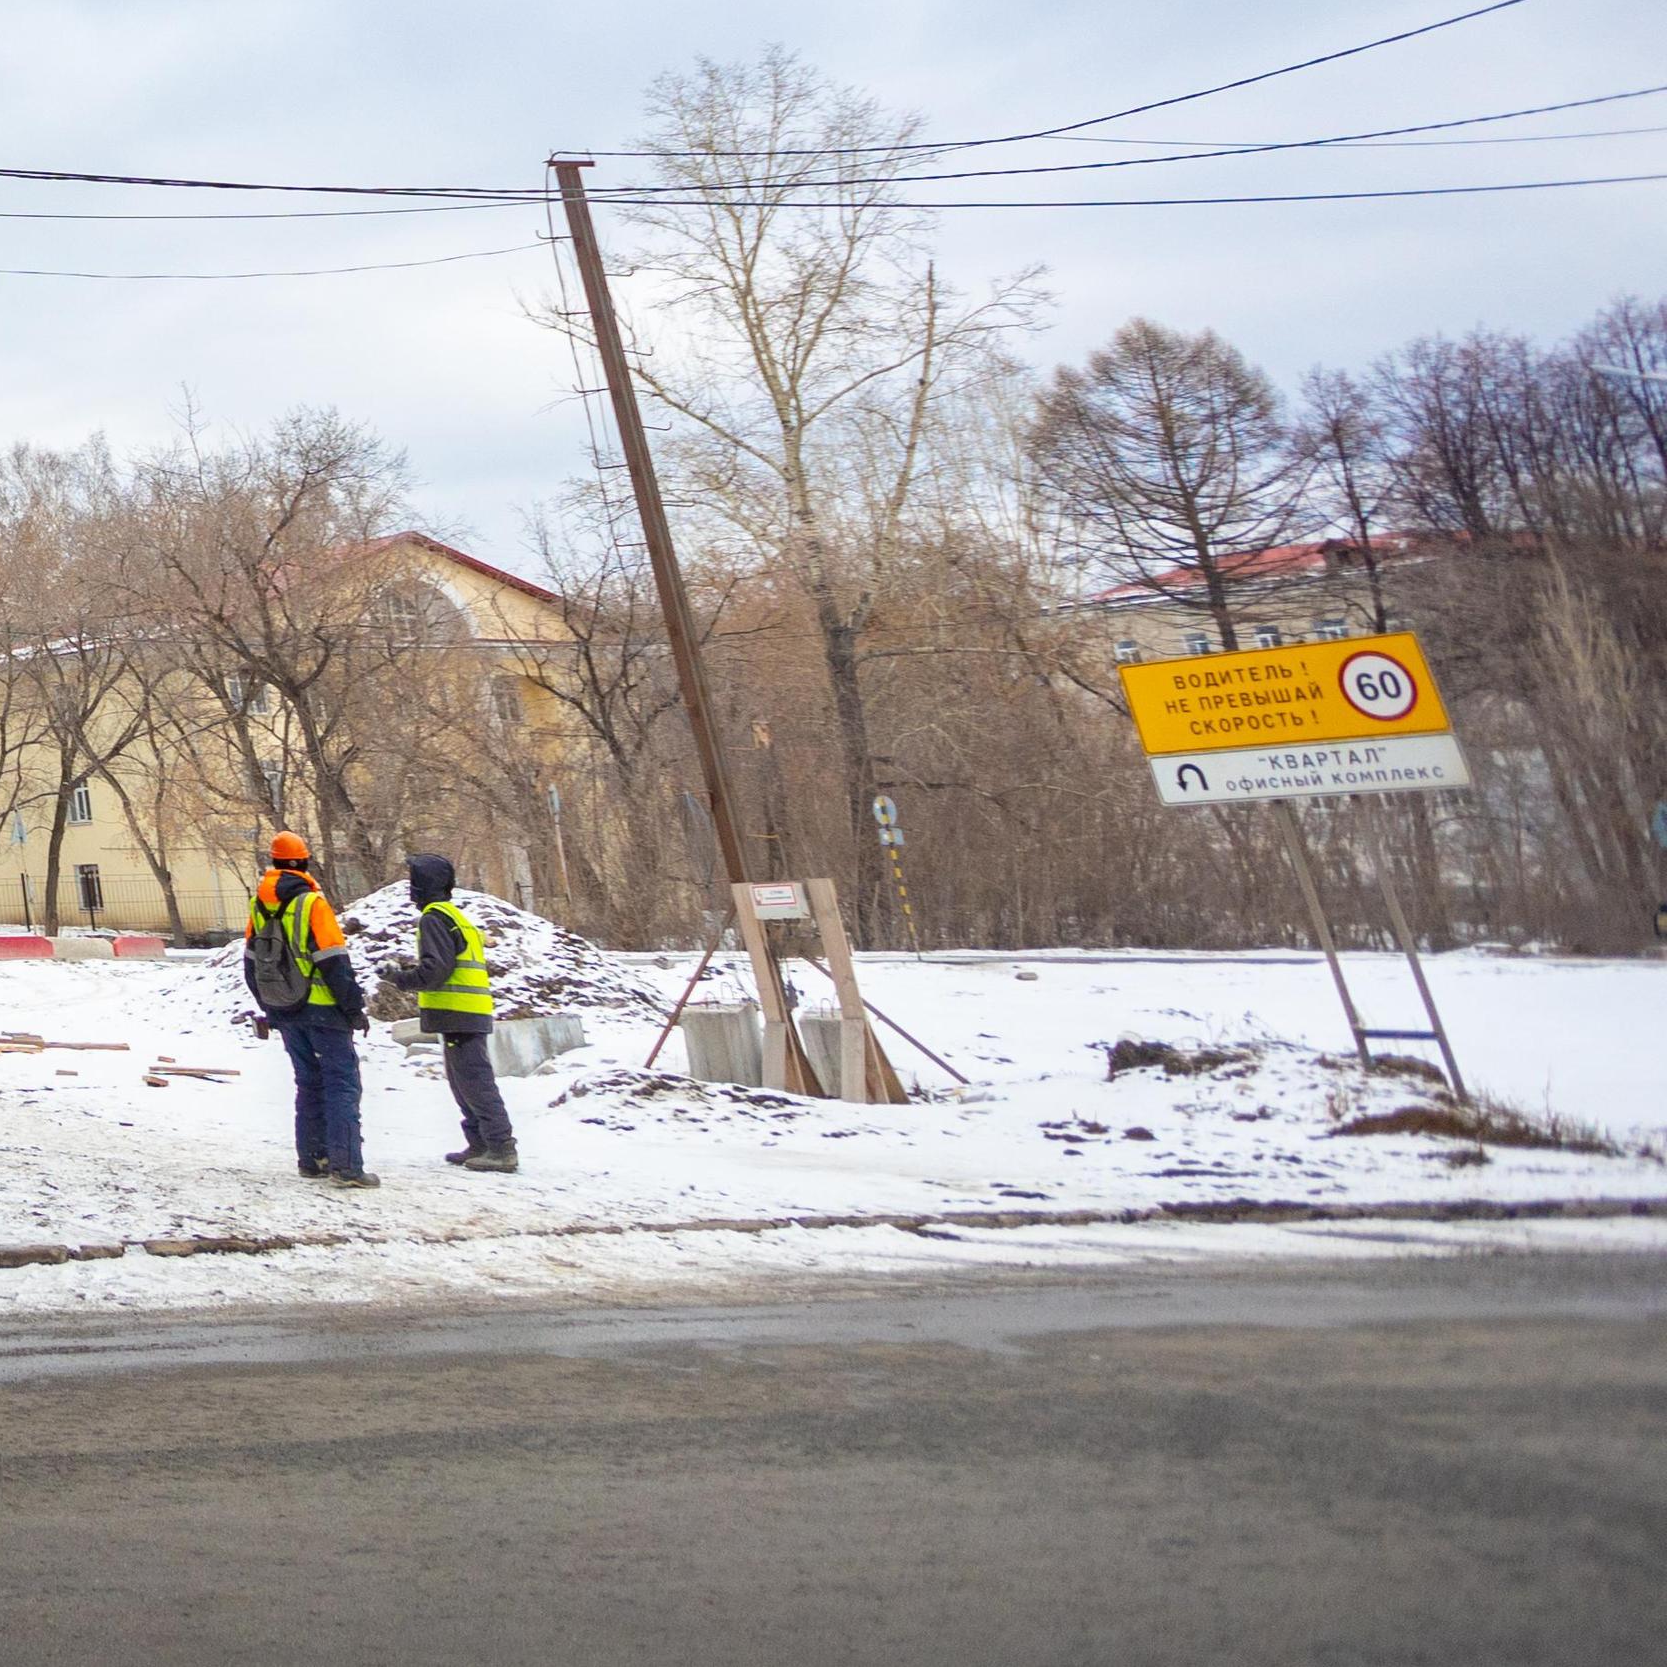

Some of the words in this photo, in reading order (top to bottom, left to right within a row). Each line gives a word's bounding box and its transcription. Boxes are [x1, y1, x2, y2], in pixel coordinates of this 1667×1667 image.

[1173, 664, 1293, 690] ВОДИТЕЛЬ
[1356, 670, 1401, 701] 60
[1165, 698, 1191, 714] НЕ
[1198, 681, 1324, 710] ПРЕВЫШАЙ
[1190, 712, 1304, 735] СКОРОСТЬ
[1257, 746, 1387, 770] "КВАРТАЛ"
[1225, 771, 1323, 794] офисный
[1332, 765, 1445, 784] комплекс
